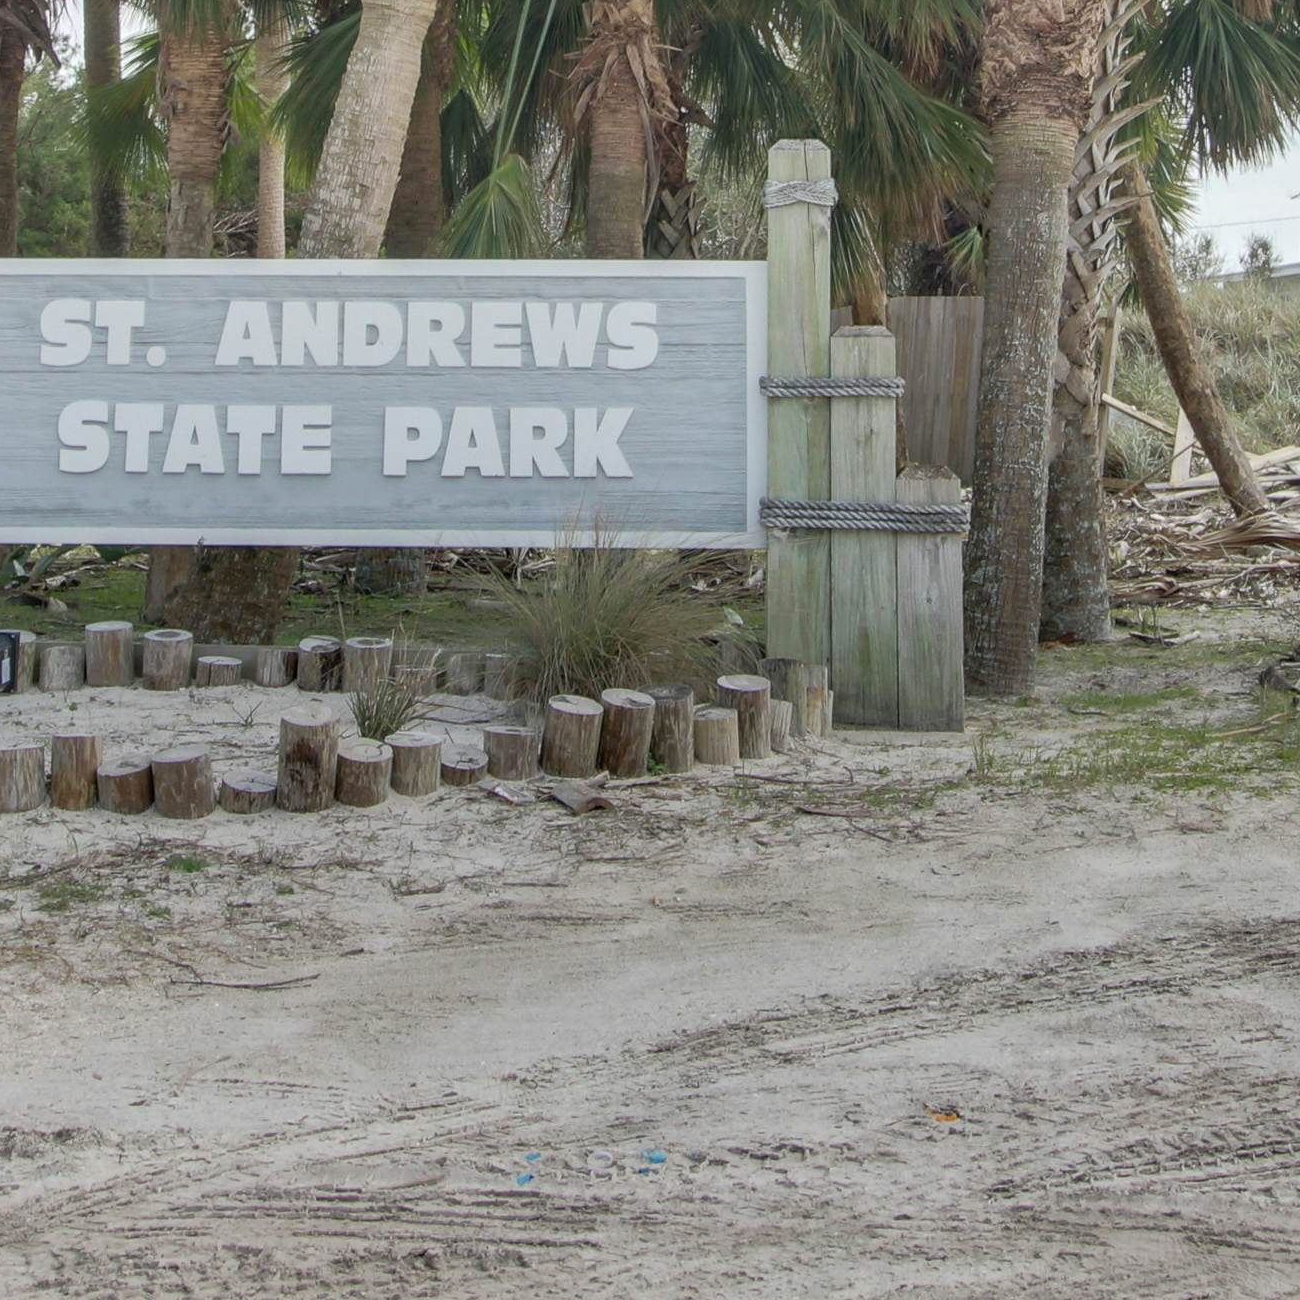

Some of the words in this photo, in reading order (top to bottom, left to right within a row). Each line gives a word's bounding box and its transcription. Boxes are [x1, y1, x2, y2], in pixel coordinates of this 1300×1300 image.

[38, 299, 167, 367] ST.
[214, 300, 660, 370] ANDREWS
[57, 399, 333, 476] STATE
[382, 405, 636, 479] PARK
